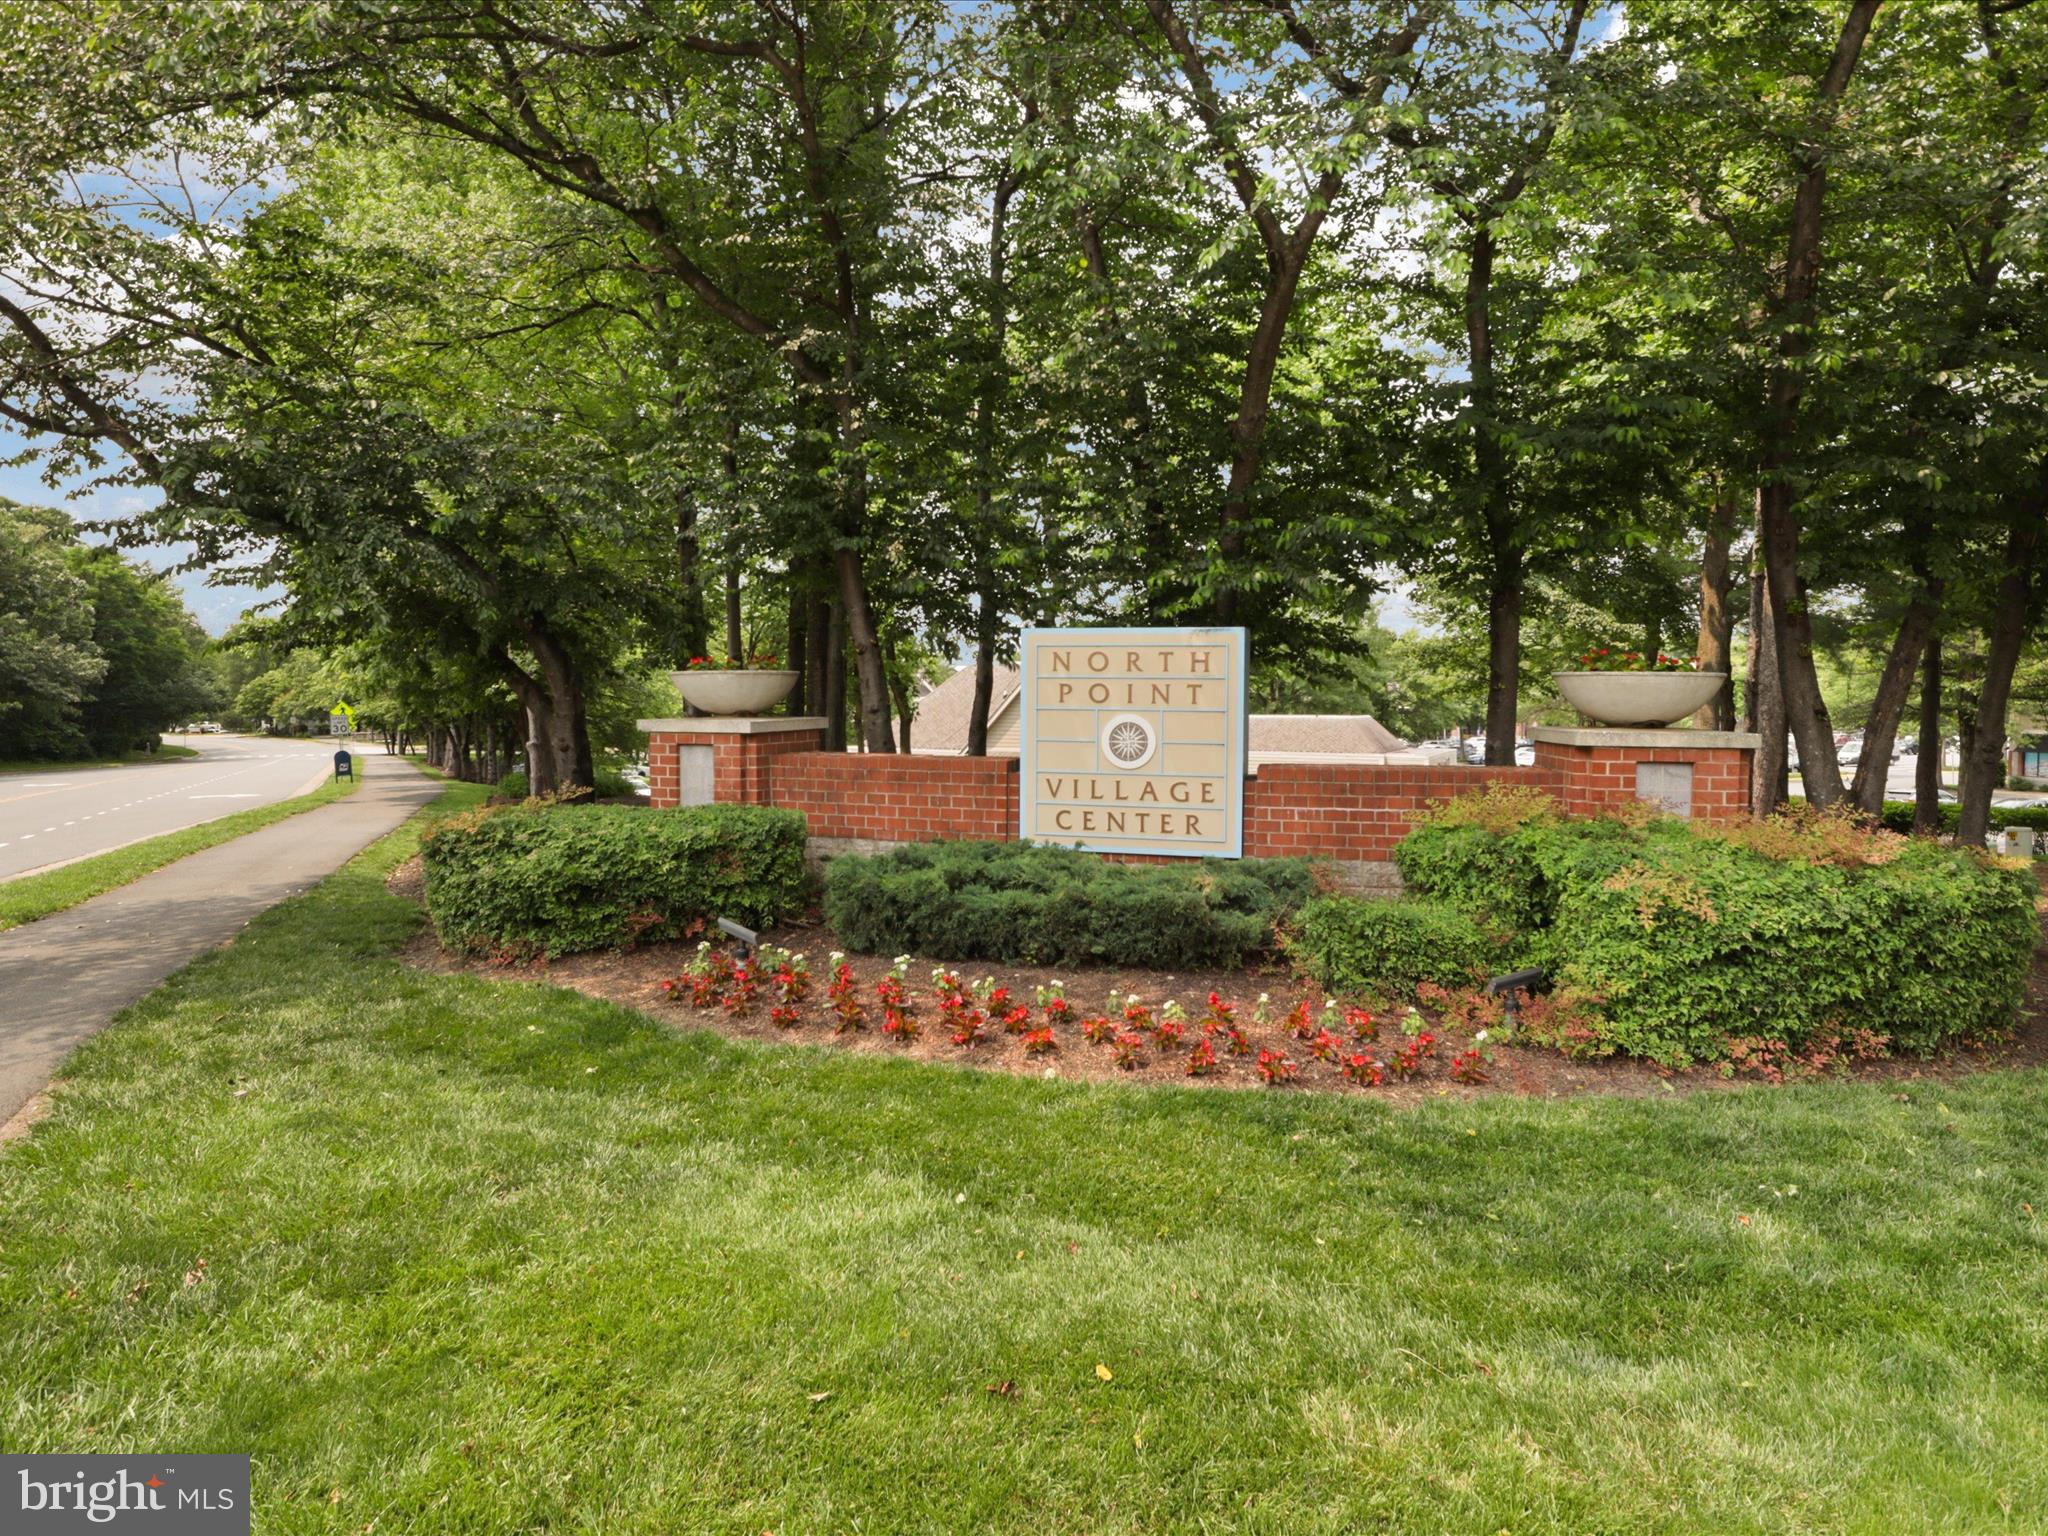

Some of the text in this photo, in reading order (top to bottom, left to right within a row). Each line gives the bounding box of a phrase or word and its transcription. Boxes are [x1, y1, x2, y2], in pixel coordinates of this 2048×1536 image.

[1052, 651, 1210, 672] NORTH
[1058, 683, 1203, 704] POINT
[332, 725, 347, 733] 30
[1046, 778, 1215, 803] VILLAGE
[1055, 810, 1202, 835] CENTER
